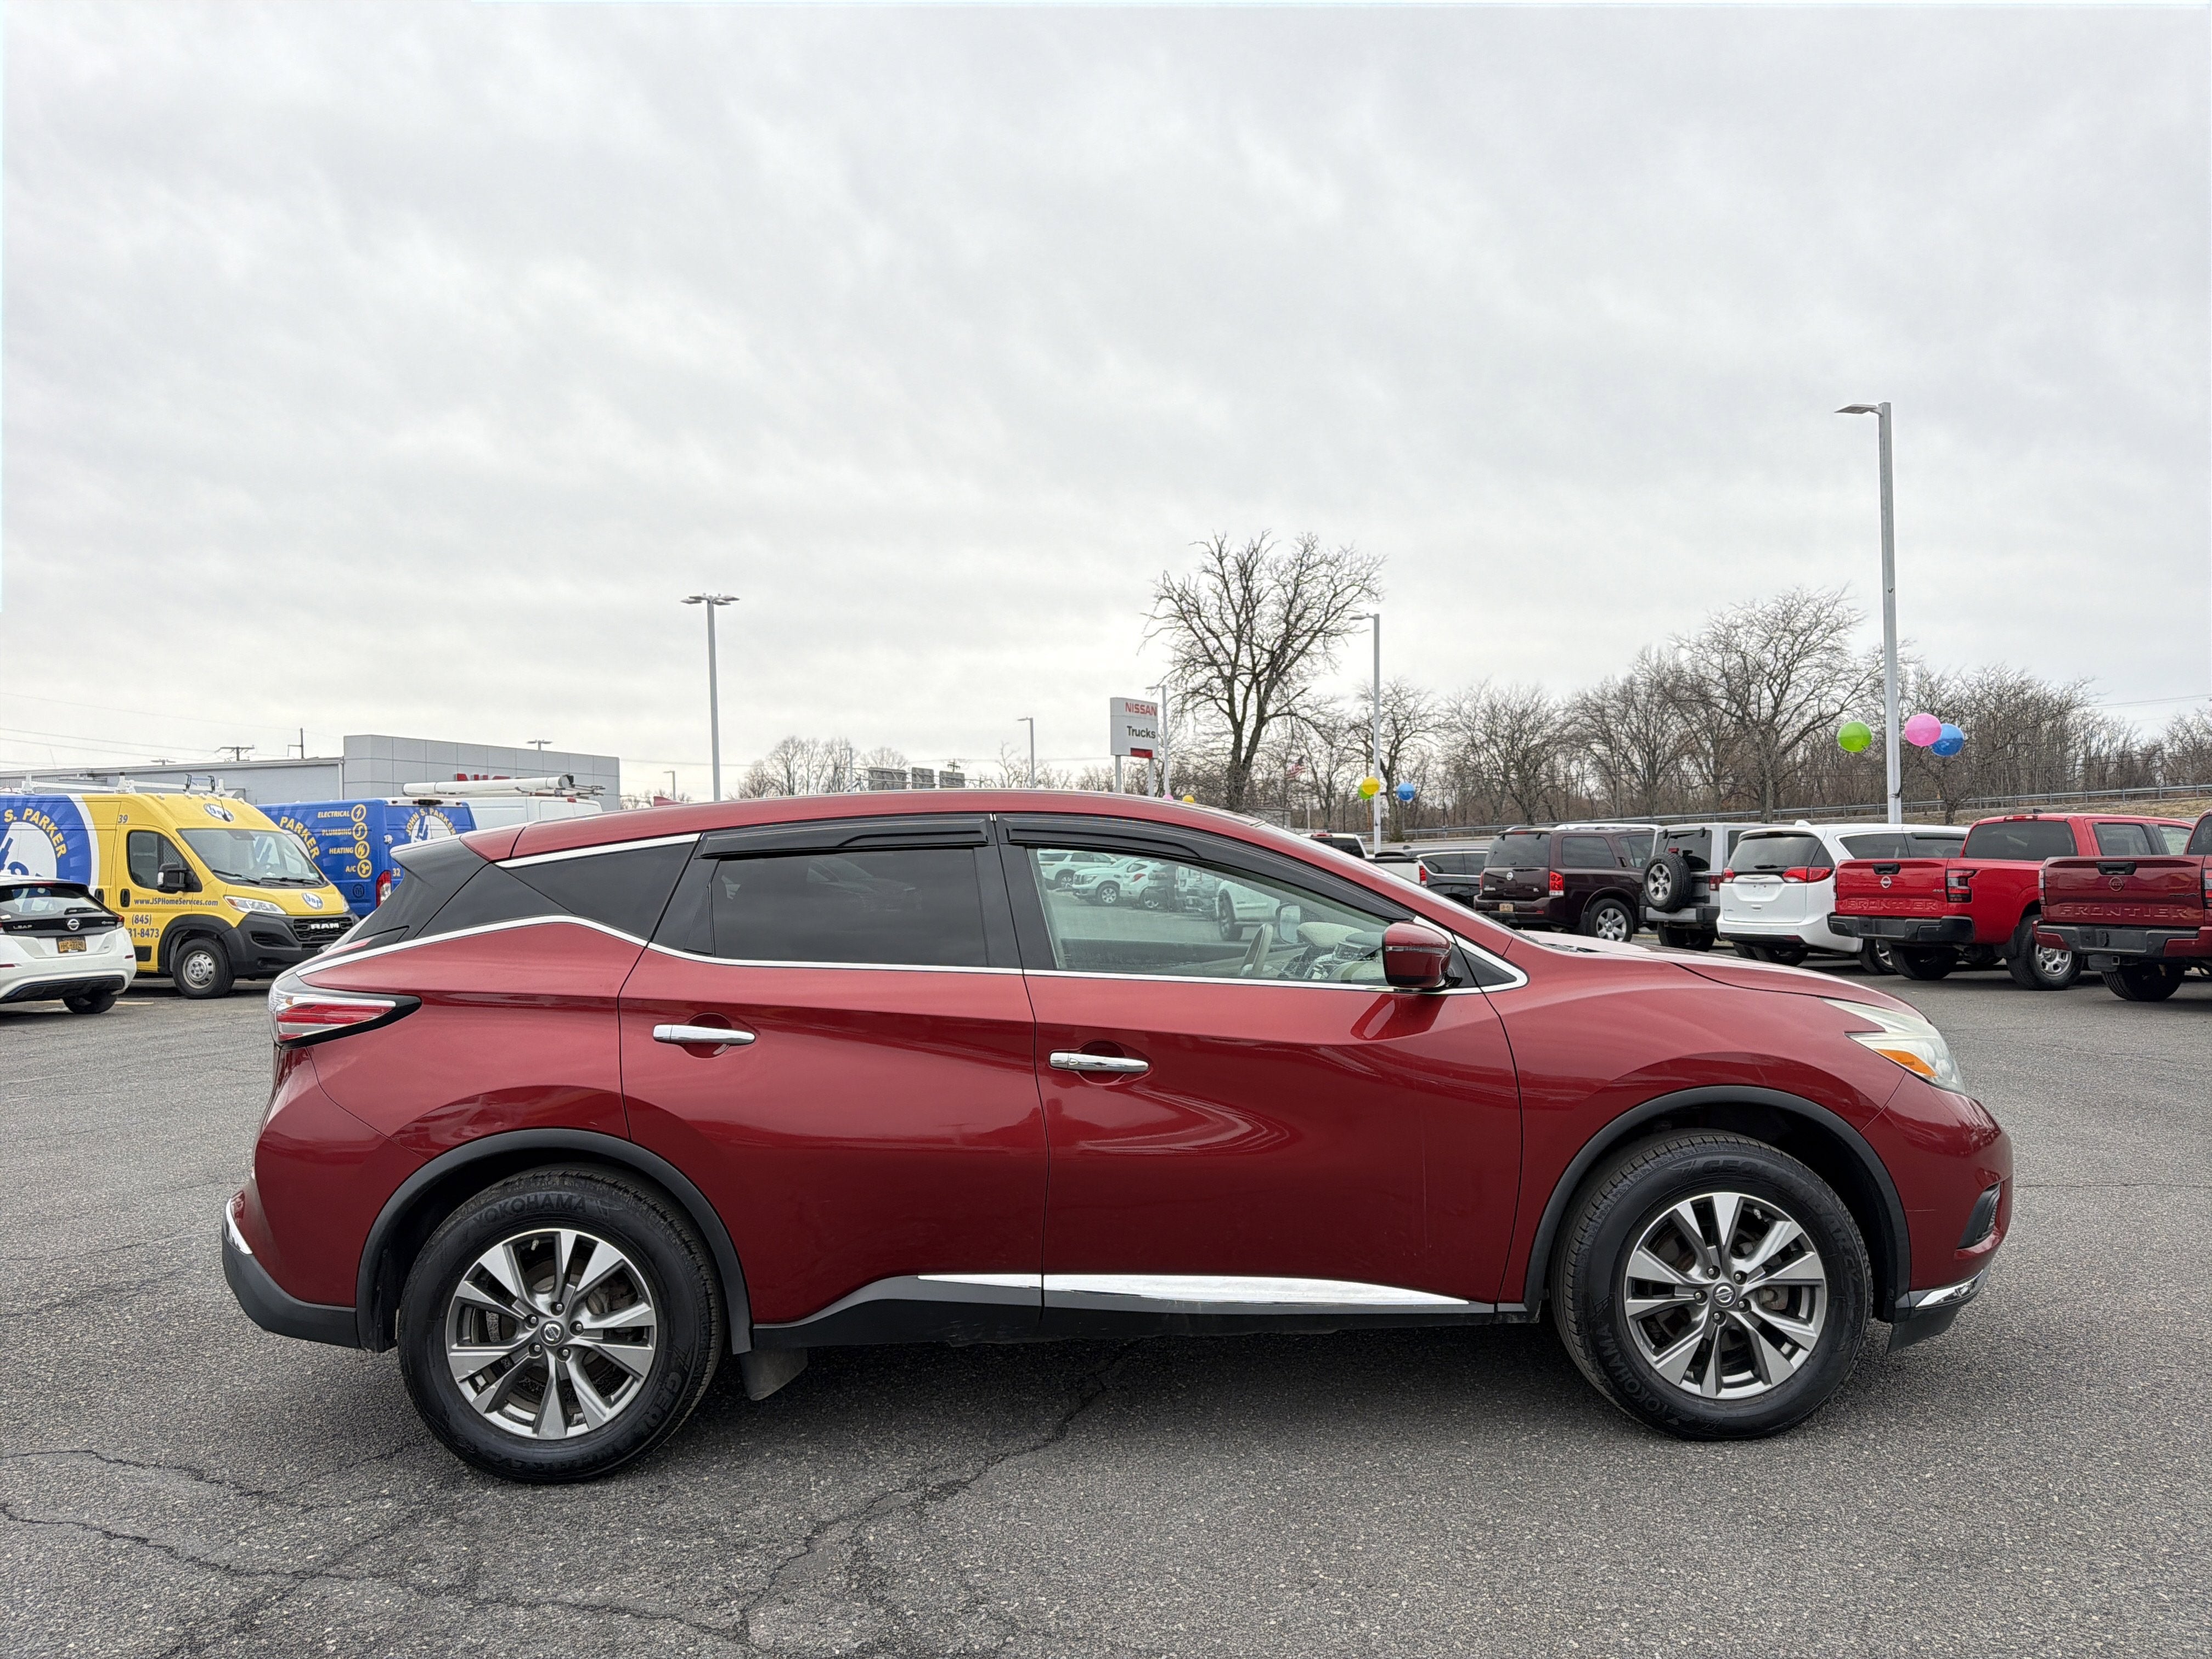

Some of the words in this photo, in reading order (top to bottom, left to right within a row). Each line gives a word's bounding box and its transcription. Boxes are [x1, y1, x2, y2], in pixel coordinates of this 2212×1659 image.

[1125, 702, 1158, 716] NISSAN
[1126, 725, 1156, 739] Trucks
[117, 814, 128, 823] 39
[317, 810, 350, 819] ELECTRICAL
[406, 812, 420, 836] JOHN
[430, 808, 456, 835] PARKER
[22, 808, 67, 859] PARKER
[279, 816, 320, 859] PARKER
[393, 868, 400, 877] 32
[134, 898, 218, 906] www.JSPHomeServices.com
[1847, 900, 1938, 910] FRONTIER
[2060, 906, 2188, 918] FRONTIER
[132, 914, 152, 926] (845)
[473, 1193, 588, 1224] YOKOHAMA
[1596, 1323, 1669, 1415] YOKOHAMA
